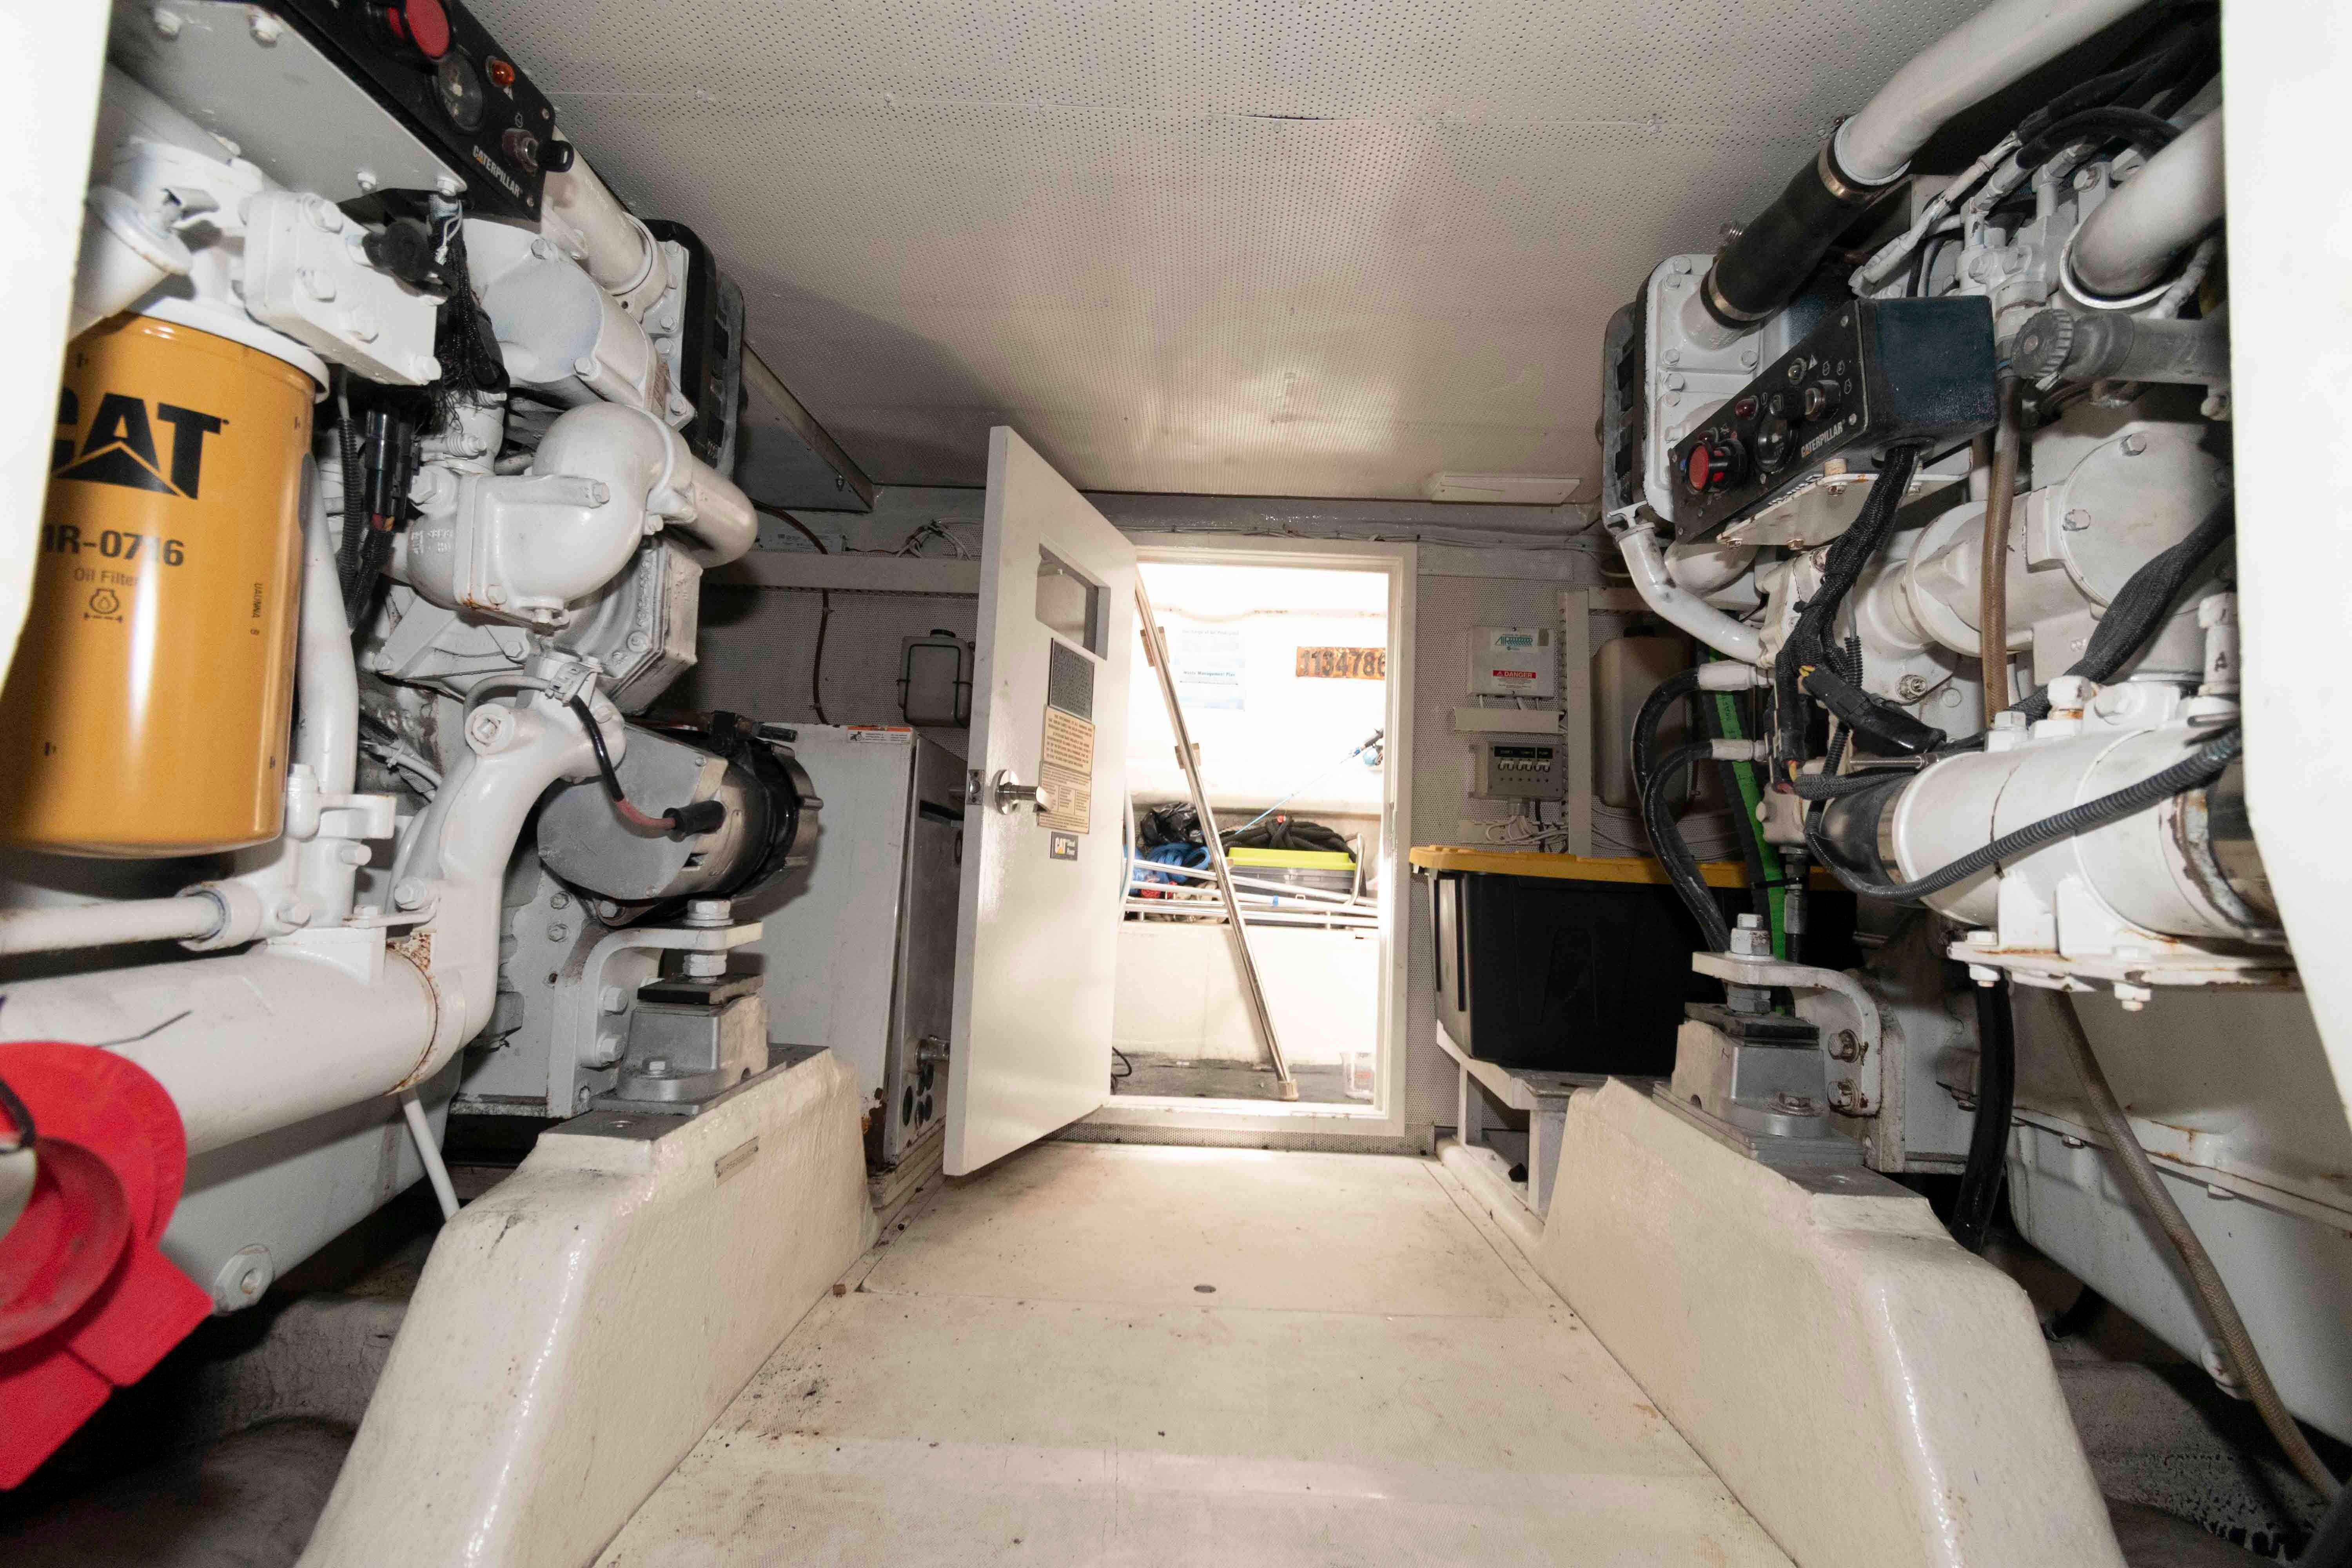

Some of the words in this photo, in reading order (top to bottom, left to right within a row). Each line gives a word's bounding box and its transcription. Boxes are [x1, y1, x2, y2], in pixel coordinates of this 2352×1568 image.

[473, 145, 520, 198] CATERPILLAR
[1801, 421, 1843, 458] CATERPILLAR
[73, 568, 95, 582] Oil
[1055, 837, 1066, 854] CAT
